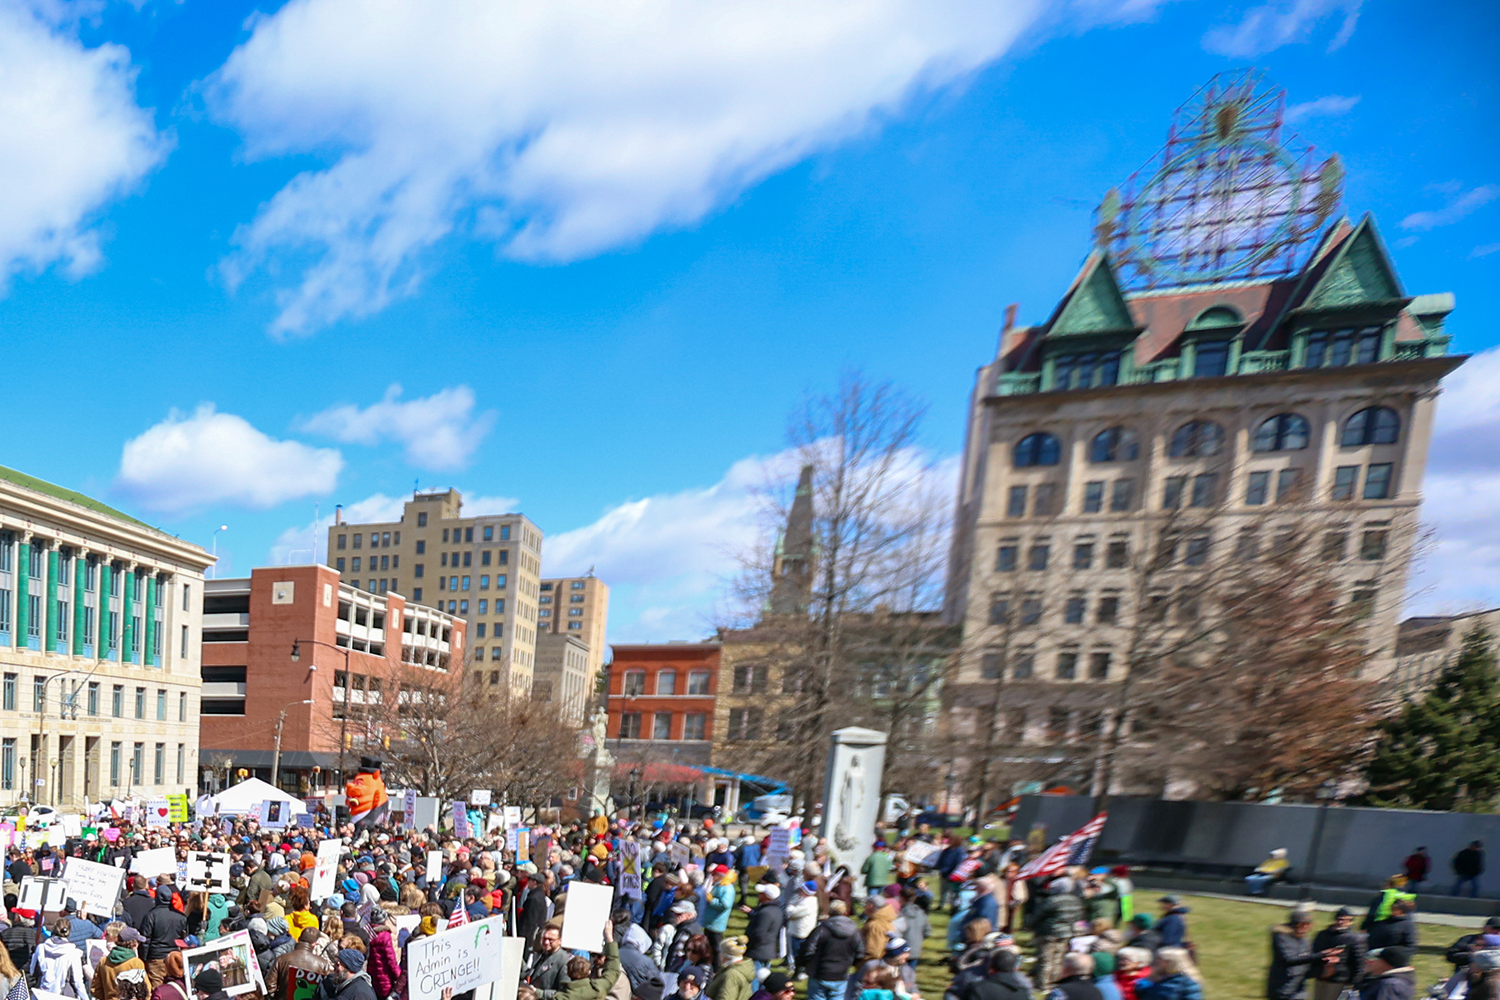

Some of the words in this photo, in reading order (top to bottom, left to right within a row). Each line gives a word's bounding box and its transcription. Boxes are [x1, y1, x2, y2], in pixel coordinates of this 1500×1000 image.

[415, 956, 450, 978] Admin
[458, 949, 469, 958] is
[421, 939, 451, 959] This
[420, 957, 480, 994] CRINGE!!
